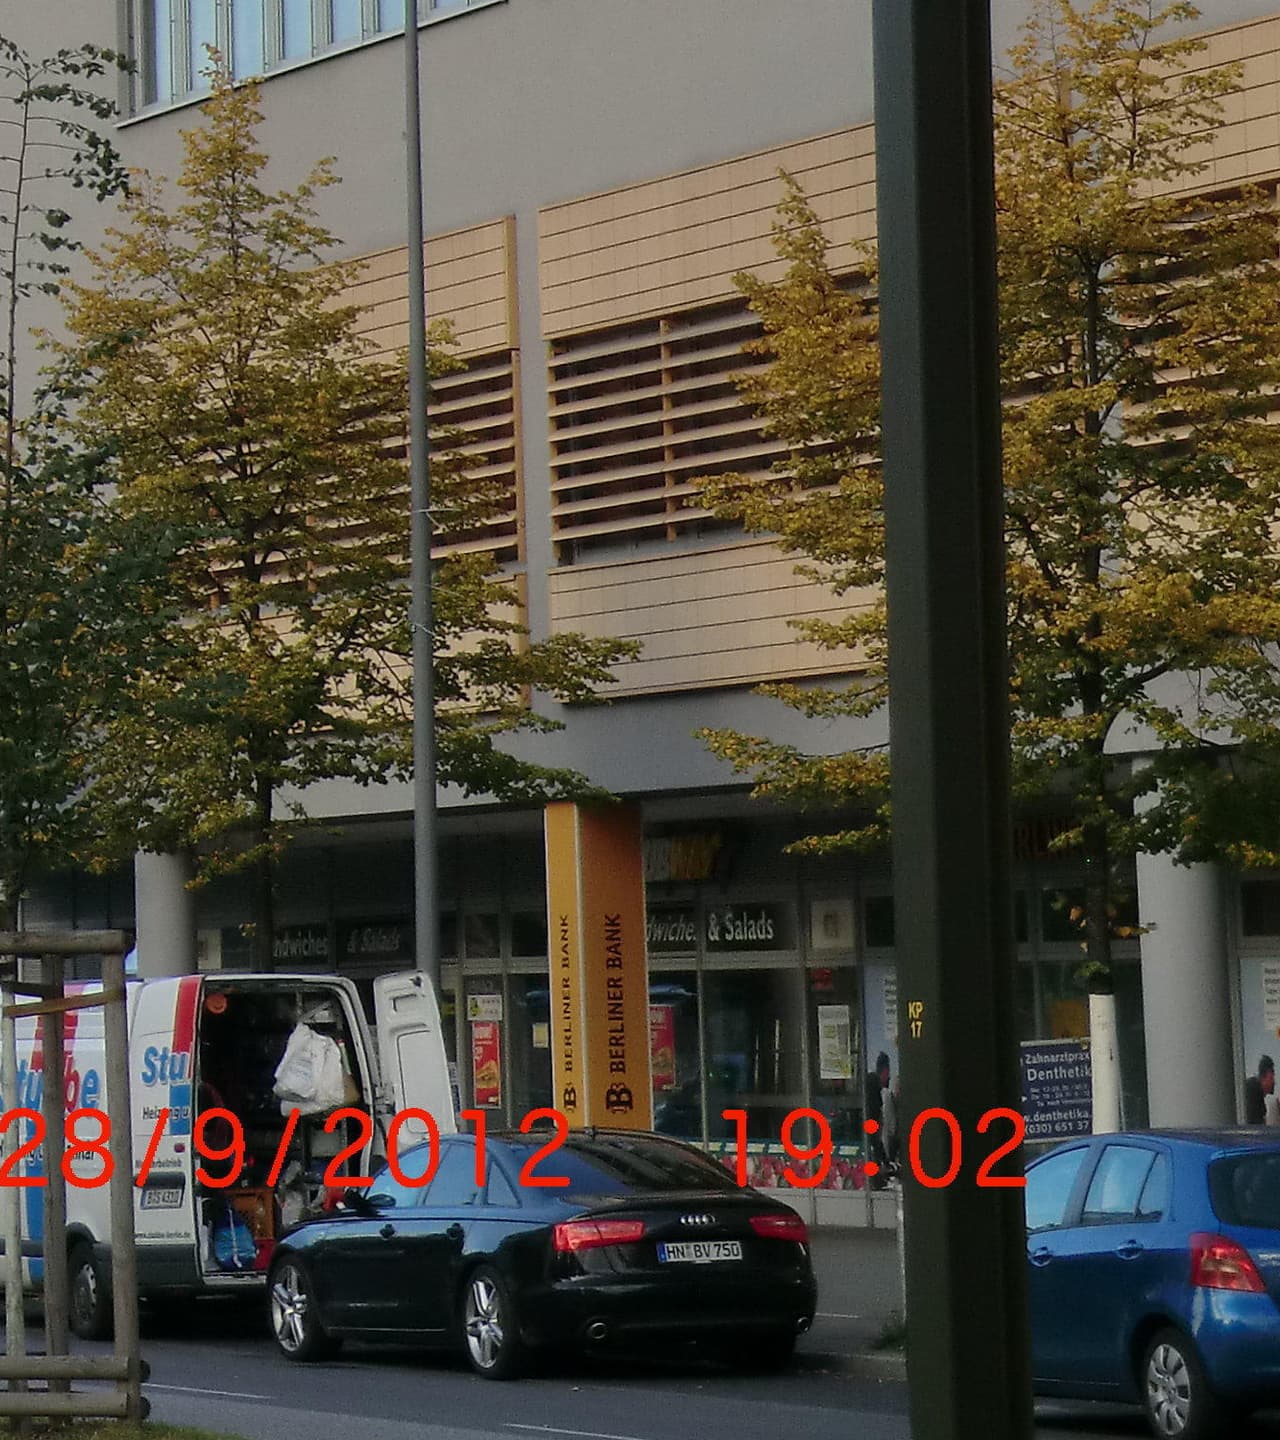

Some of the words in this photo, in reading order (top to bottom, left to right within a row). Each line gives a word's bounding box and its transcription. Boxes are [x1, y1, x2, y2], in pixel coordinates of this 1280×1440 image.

[725, 911, 774, 940] Salads
[605, 913, 622, 970] BANK
[562, 976, 573, 1072] BERLINER
[908, 1001, 924, 1019] KP
[607, 976, 626, 1074] BERLINER
[910, 1020, 923, 1038] 17
[693, 1243, 711, 1258] BV
